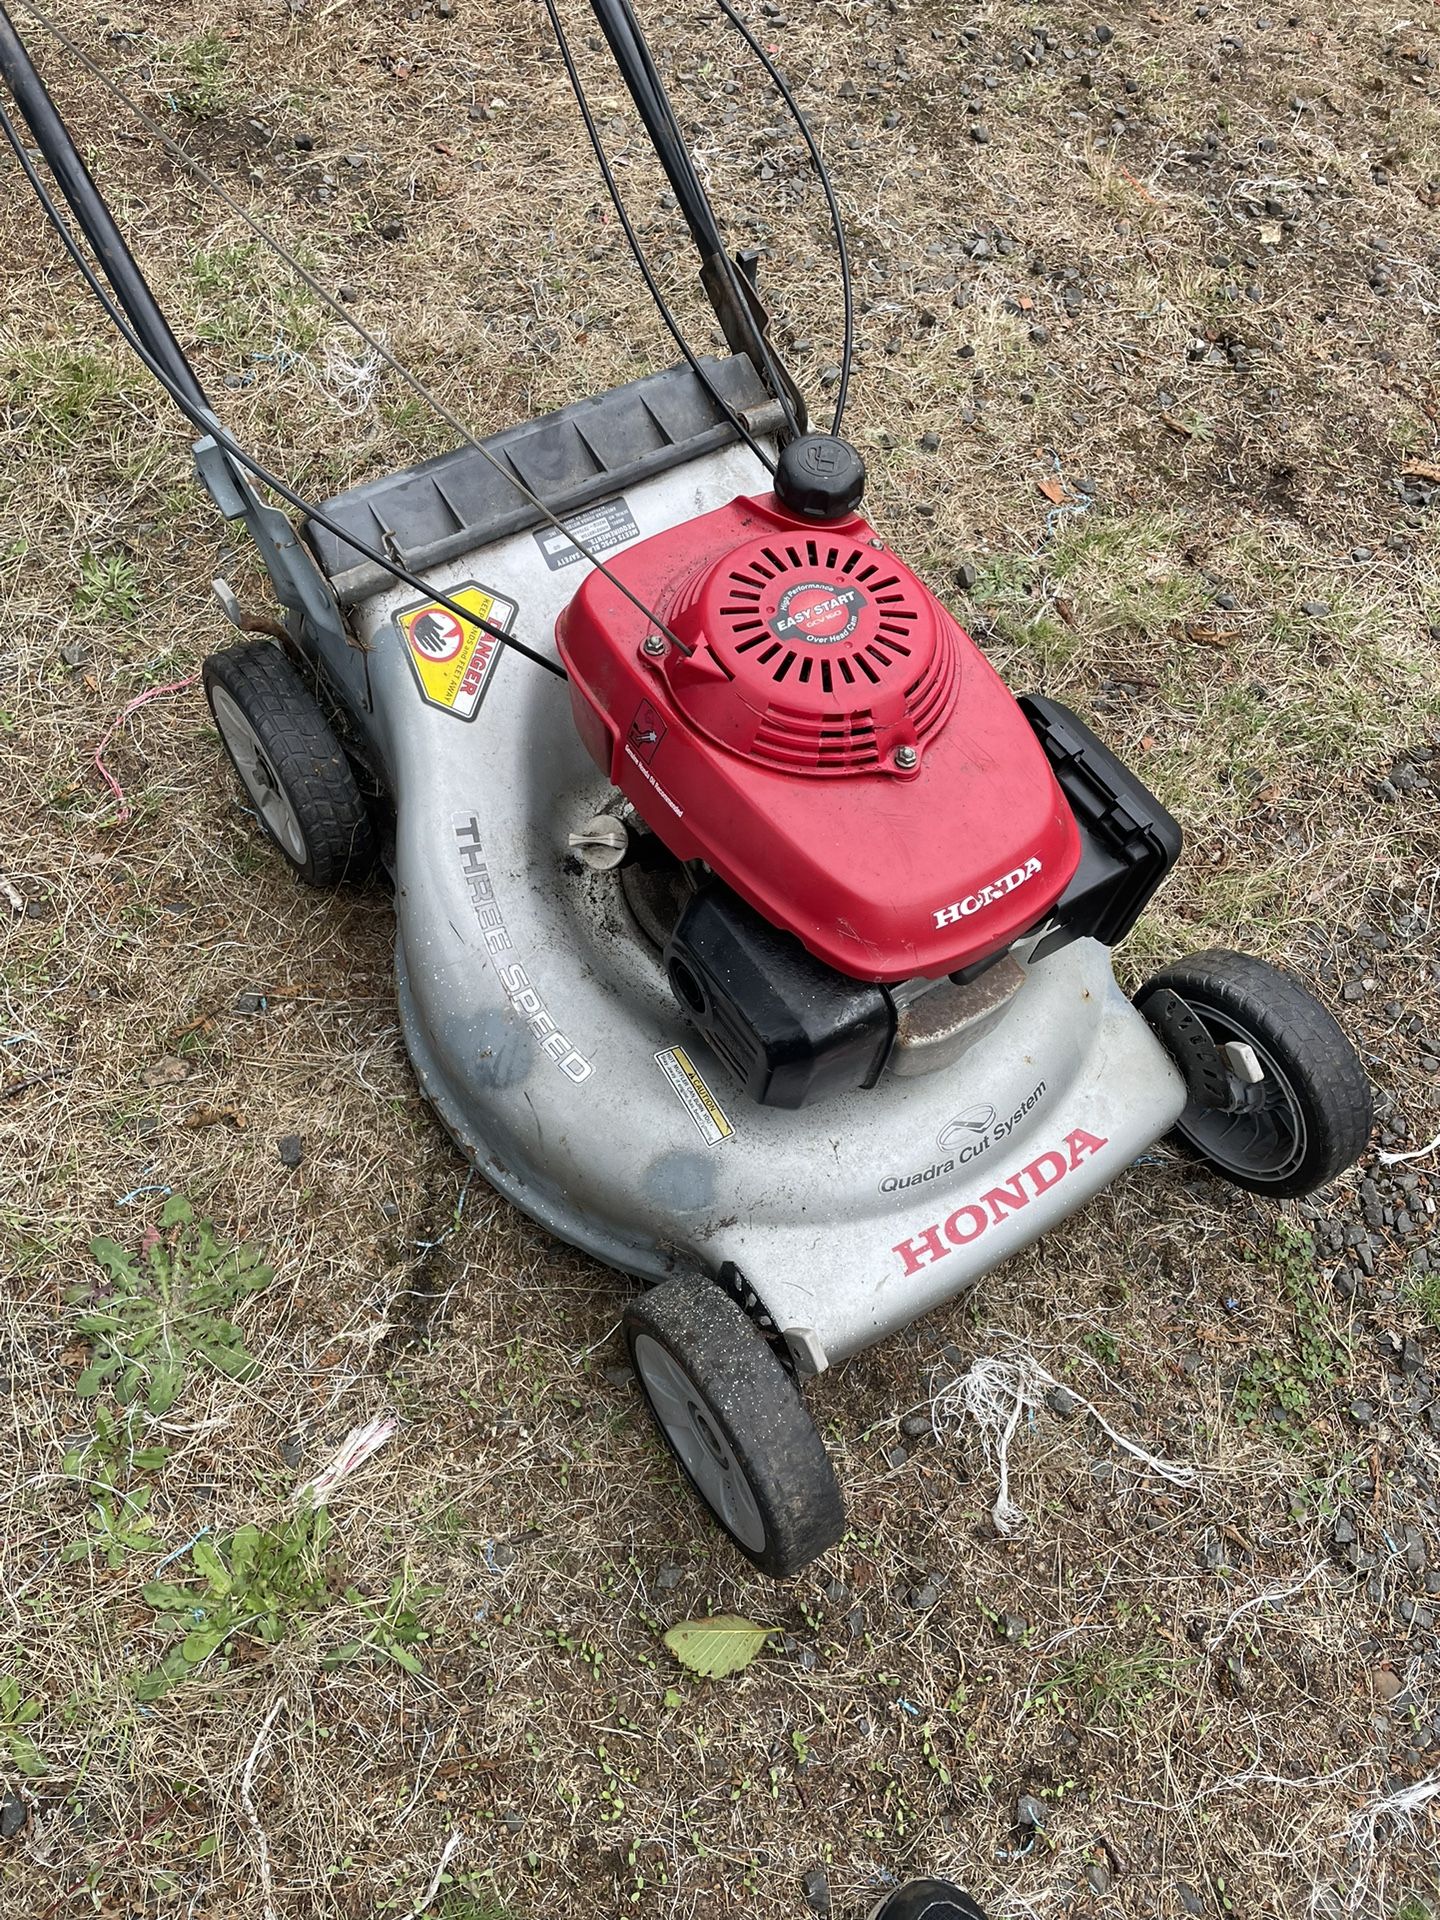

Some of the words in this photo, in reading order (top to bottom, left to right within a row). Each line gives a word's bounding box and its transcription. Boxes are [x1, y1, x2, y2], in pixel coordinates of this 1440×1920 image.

[617, 527, 638, 541] MEETS
[556, 551, 581, 567] SAFETY
[478, 598, 490, 618] KEEP
[776, 609, 811, 631] EASY
[813, 591, 855, 615] START
[780, 596, 790, 611] High
[787, 583, 834, 597] Performance
[806, 634, 828, 643] Over
[829, 629, 849, 642] Head
[846, 615, 858, 631] Cam
[459, 616, 503, 696] DANGER
[460, 644, 469, 659] and
[452, 660, 465, 680] FEET
[444, 680, 458, 703] AWAY
[933, 856, 1042, 929] HONDA
[455, 816, 513, 955] THREE
[500, 962, 594, 1084] SPEED
[665, 1052, 675, 1064] HOT
[673, 1064, 689, 1086] MUFFLER
[686, 1086, 696, 1098] CAN
[693, 1098, 705, 1112] BURN
[693, 1079, 716, 1112] CAUTION
[881, 1158, 955, 1193] Quadra
[959, 1134, 990, 1164] Cut
[993, 1080, 1047, 1141] System
[891, 1127, 1109, 1277] HONDA
